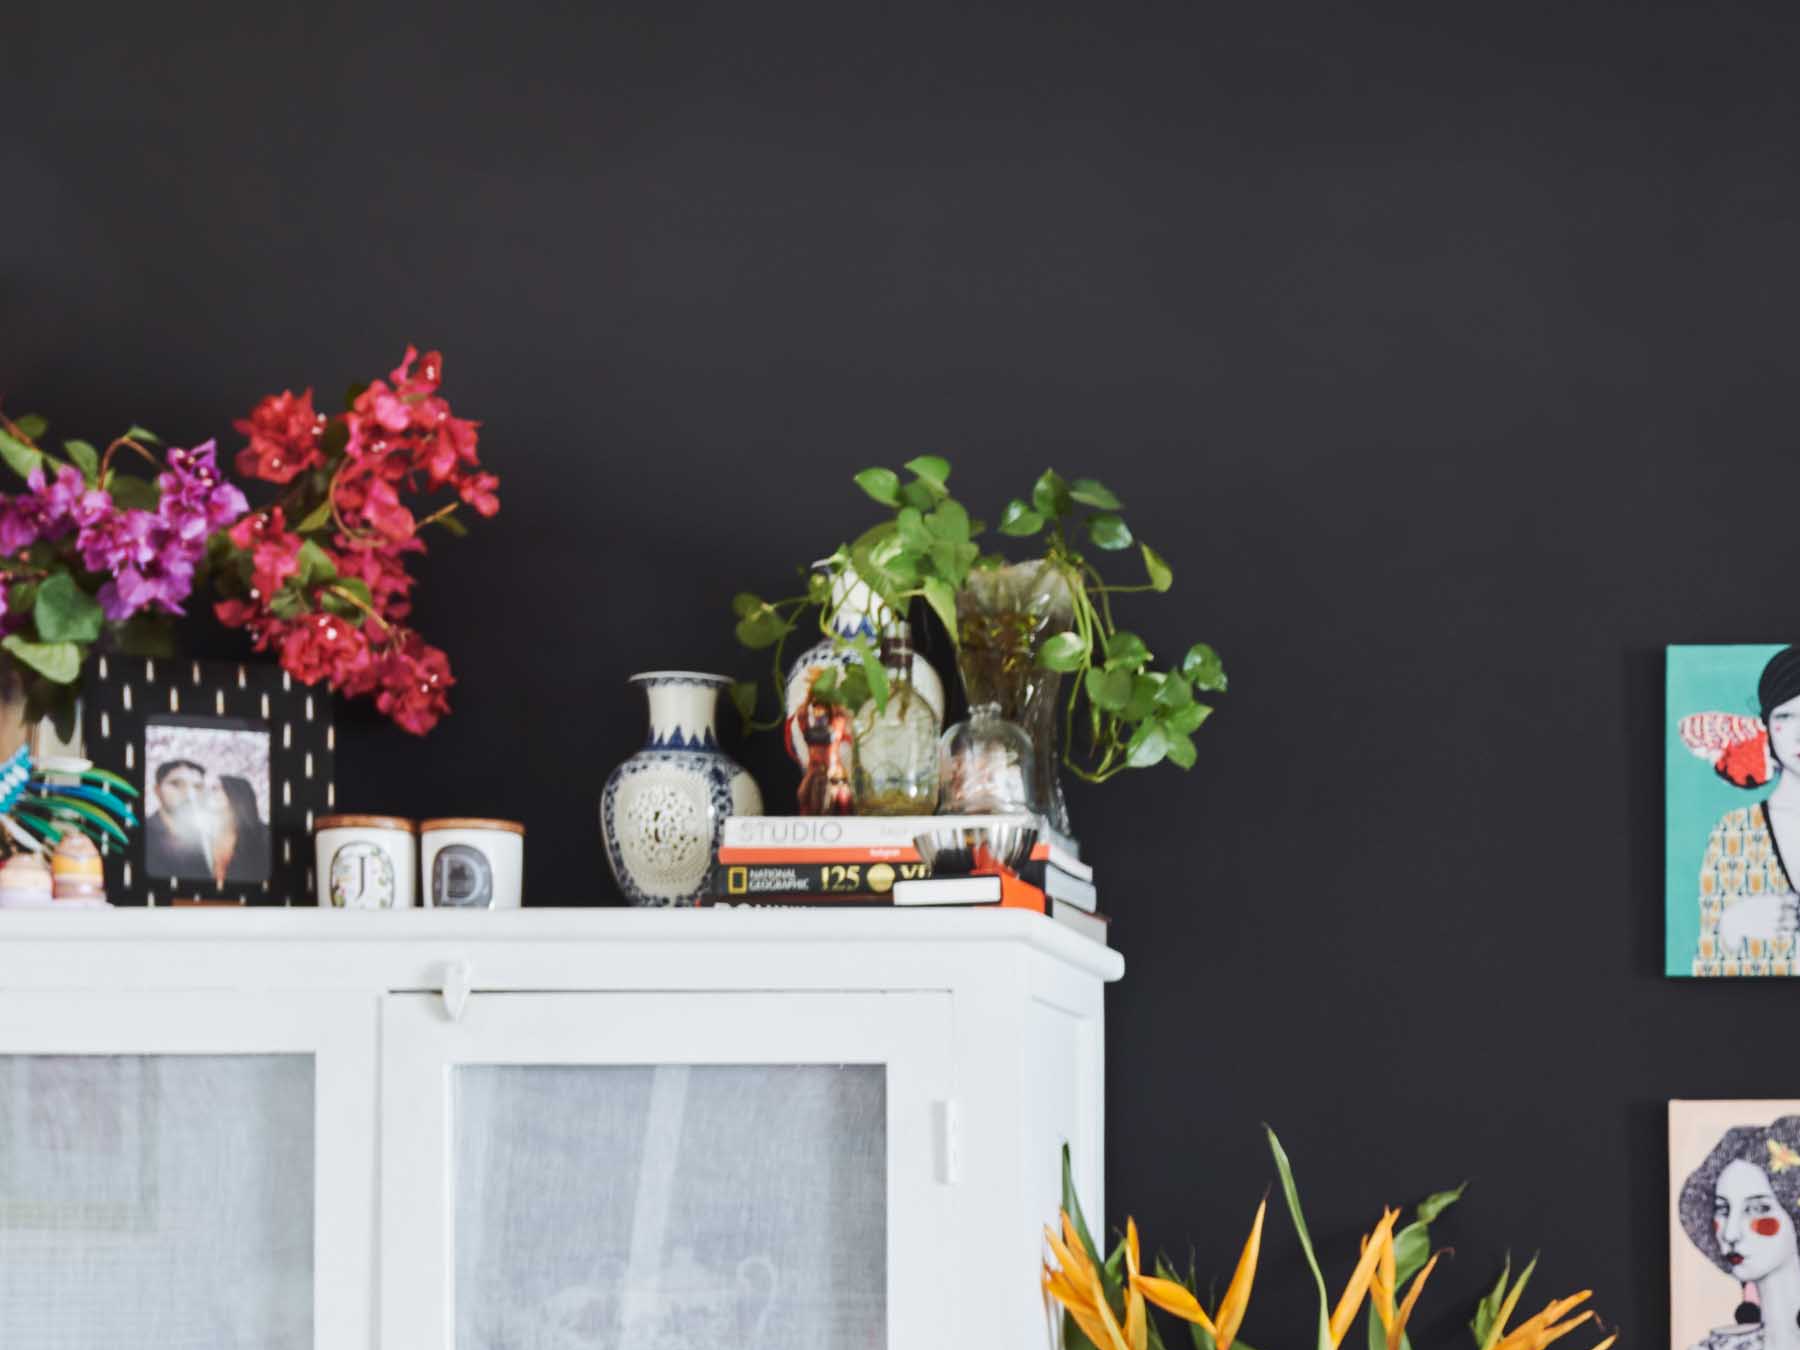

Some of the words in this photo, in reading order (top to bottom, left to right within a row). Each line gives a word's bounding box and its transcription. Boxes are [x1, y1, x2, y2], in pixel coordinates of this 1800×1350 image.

[739, 821, 843, 843] STUDIO
[353, 856, 369, 902] J
[439, 853, 484, 905] D
[748, 877, 810, 892] GEOGRAPHIC
[749, 868, 796, 879] NATIONAL
[820, 864, 861, 892] 125
